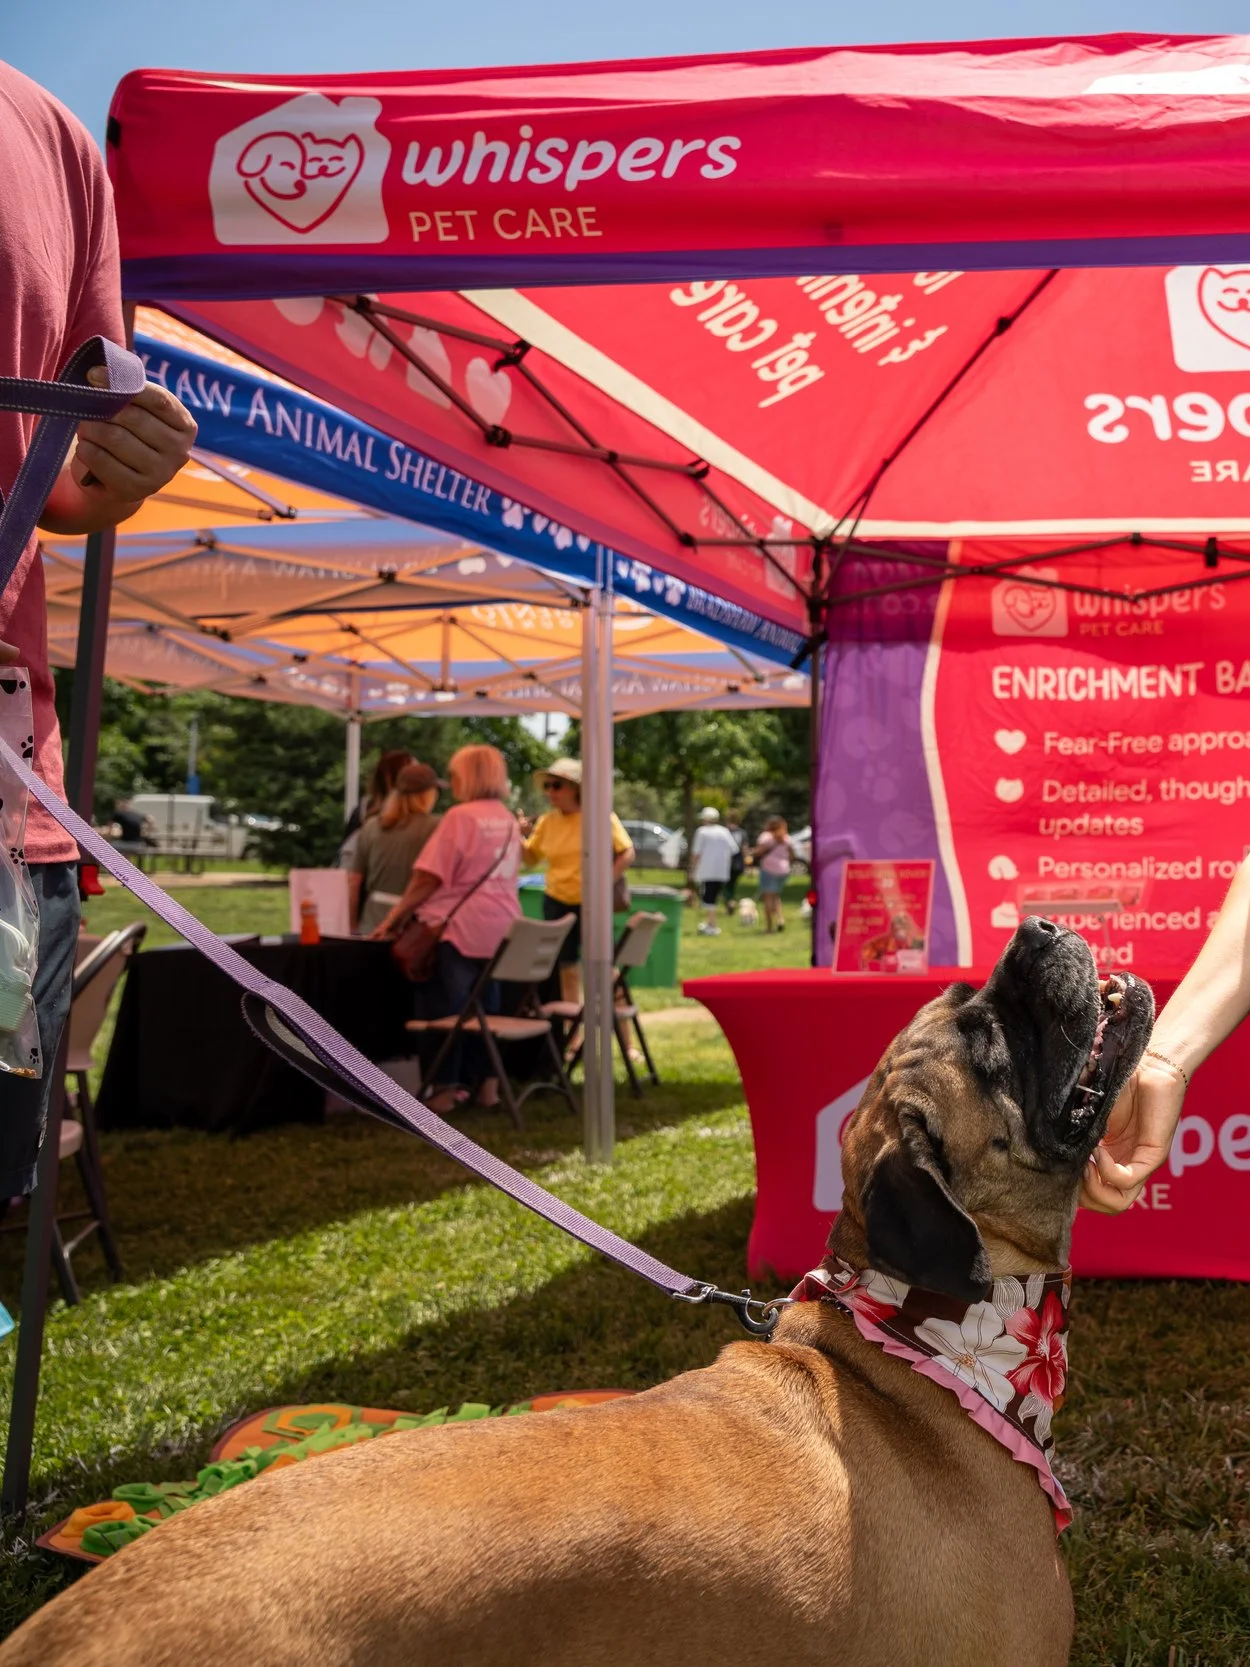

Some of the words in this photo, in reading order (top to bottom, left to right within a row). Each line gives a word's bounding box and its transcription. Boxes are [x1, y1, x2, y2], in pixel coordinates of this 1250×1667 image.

[400, 125, 742, 191] whispers
[409, 210, 479, 243] PET
[492, 206, 604, 242] CARE
[140, 353, 236, 417] HAW
[245, 378, 380, 473] ANIMAL
[388, 439, 492, 517] SHELTER
[1079, 621, 1113, 636] PET
[1115, 620, 1164, 636] CARE
[991, 661, 1205, 701] ENRICHMENT
[1043, 731, 1164, 757] Fear-Free
[1042, 778, 1153, 806] Detailed,
[1038, 813, 1144, 839] updates
[1038, 856, 1203, 880] Personalized
[1046, 906, 1200, 932] xperienced
